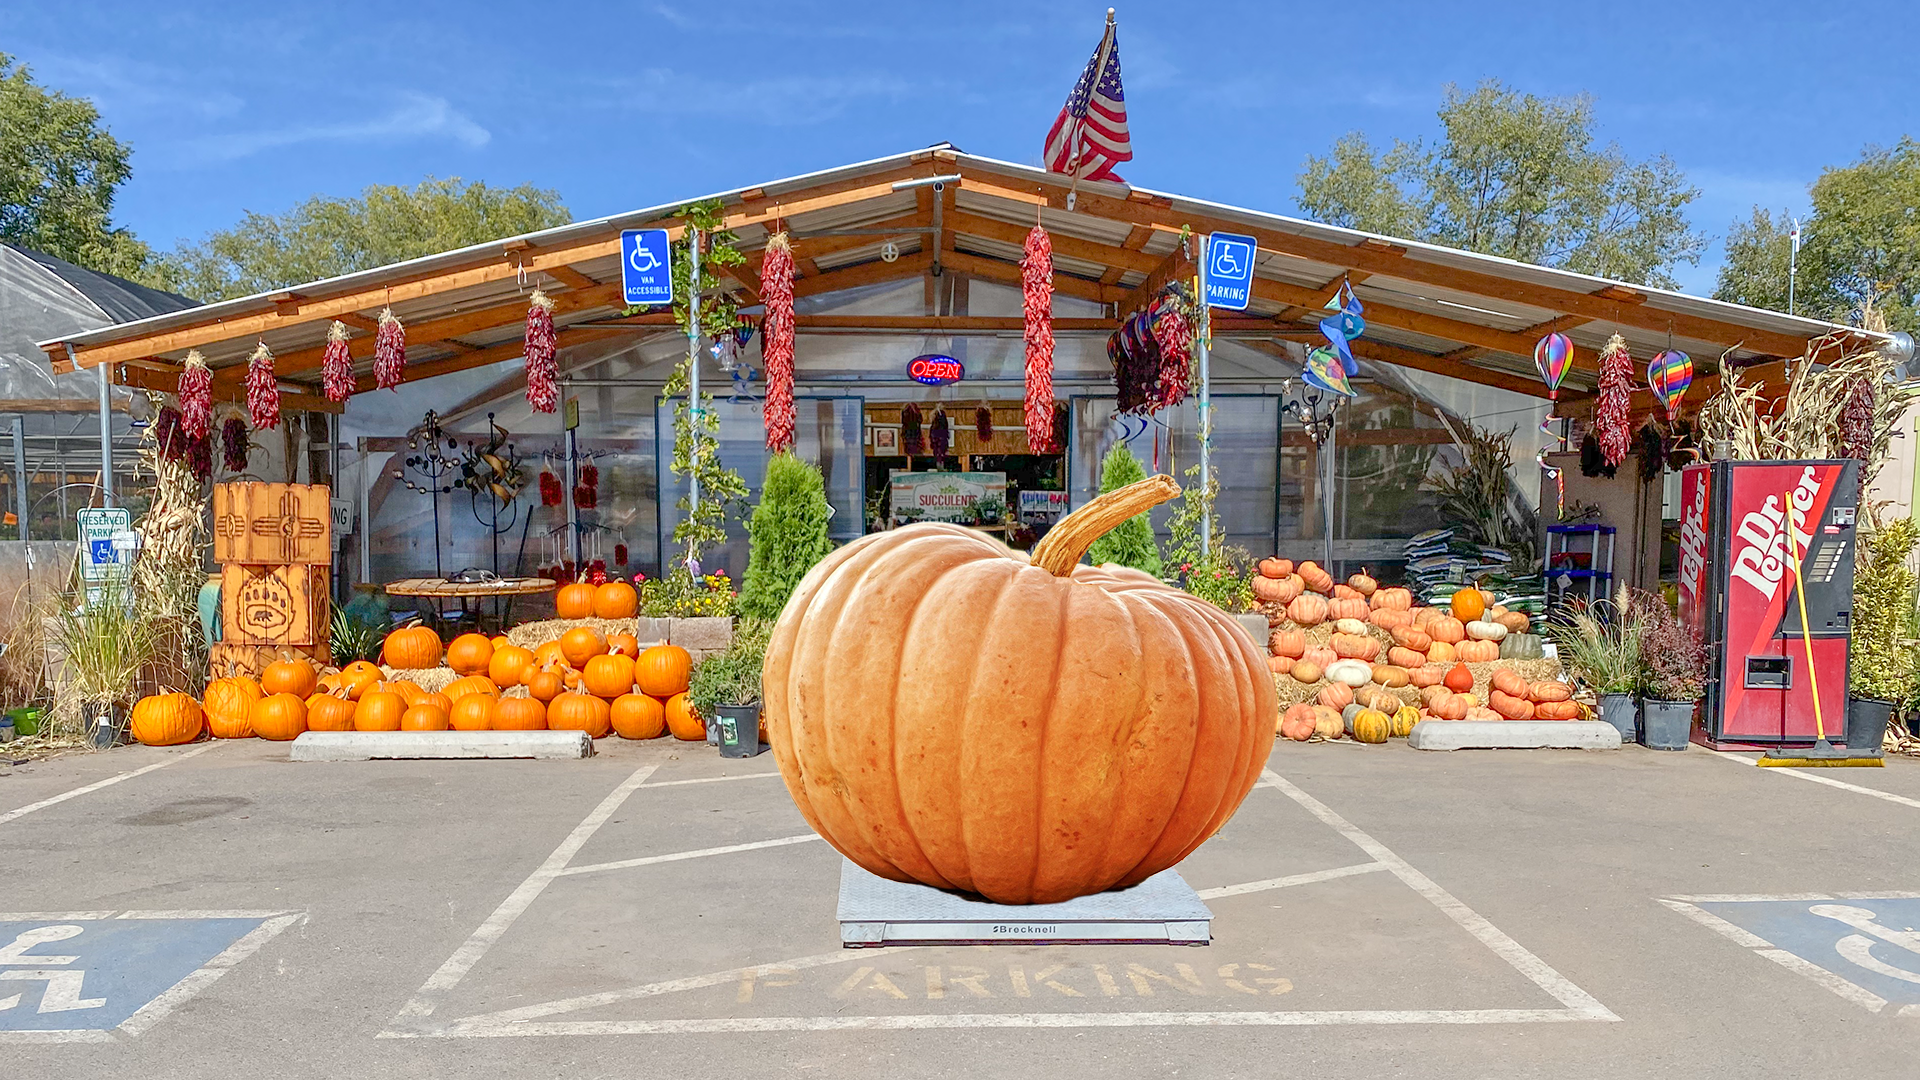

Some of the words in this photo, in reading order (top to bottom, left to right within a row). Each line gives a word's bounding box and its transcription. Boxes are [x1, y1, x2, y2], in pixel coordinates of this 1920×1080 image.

[628, 286, 669, 295] ACCESSIBLE
[641, 276, 655, 284] VAN
[1207, 284, 1245, 301] PARKING
[911, 360, 961, 379] OPEN
[82, 516, 125, 526] RESERVED
[1681, 504, 1697, 556] Dr
[1681, 472, 1706, 600] Pepper
[1731, 465, 1822, 602] Pepper
[1736, 494, 1785, 555] Dr
[736, 961, 1294, 1004] PARKING
